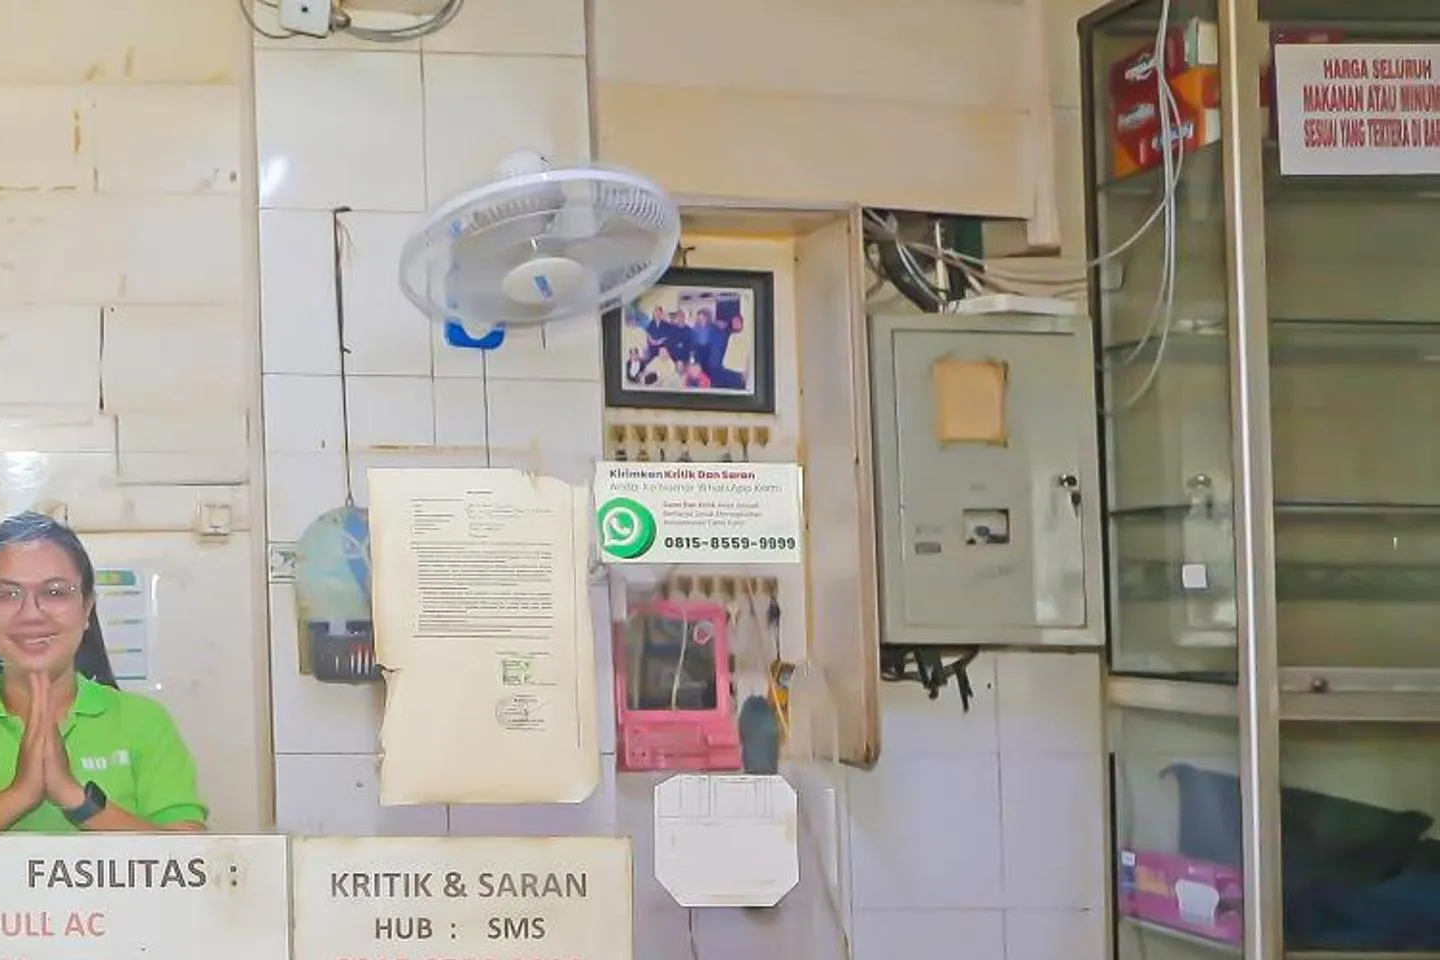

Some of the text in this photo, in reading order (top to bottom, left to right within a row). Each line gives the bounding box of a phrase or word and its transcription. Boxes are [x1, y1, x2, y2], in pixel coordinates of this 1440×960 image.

[1324, 58, 1432, 79] HARGA SELURUH
[1303, 84, 1364, 112] MAKANAN
[1367, 84, 1397, 112] ATAU
[1304, 118, 1337, 148] SESUAI
[1340, 118, 1366, 148] YANG
[610, 468, 756, 480] Kirimkan Kritik Dan Saran
[664, 536, 796, 550] 0815-8559-9999
[28, 858, 208, 889] FASILITAS
[331, 872, 588, 898] KRITIK & SARAN
[63, 912, 106, 938] AC
[374, 917, 433, 940] HUB
[487, 917, 546, 940] SMS
